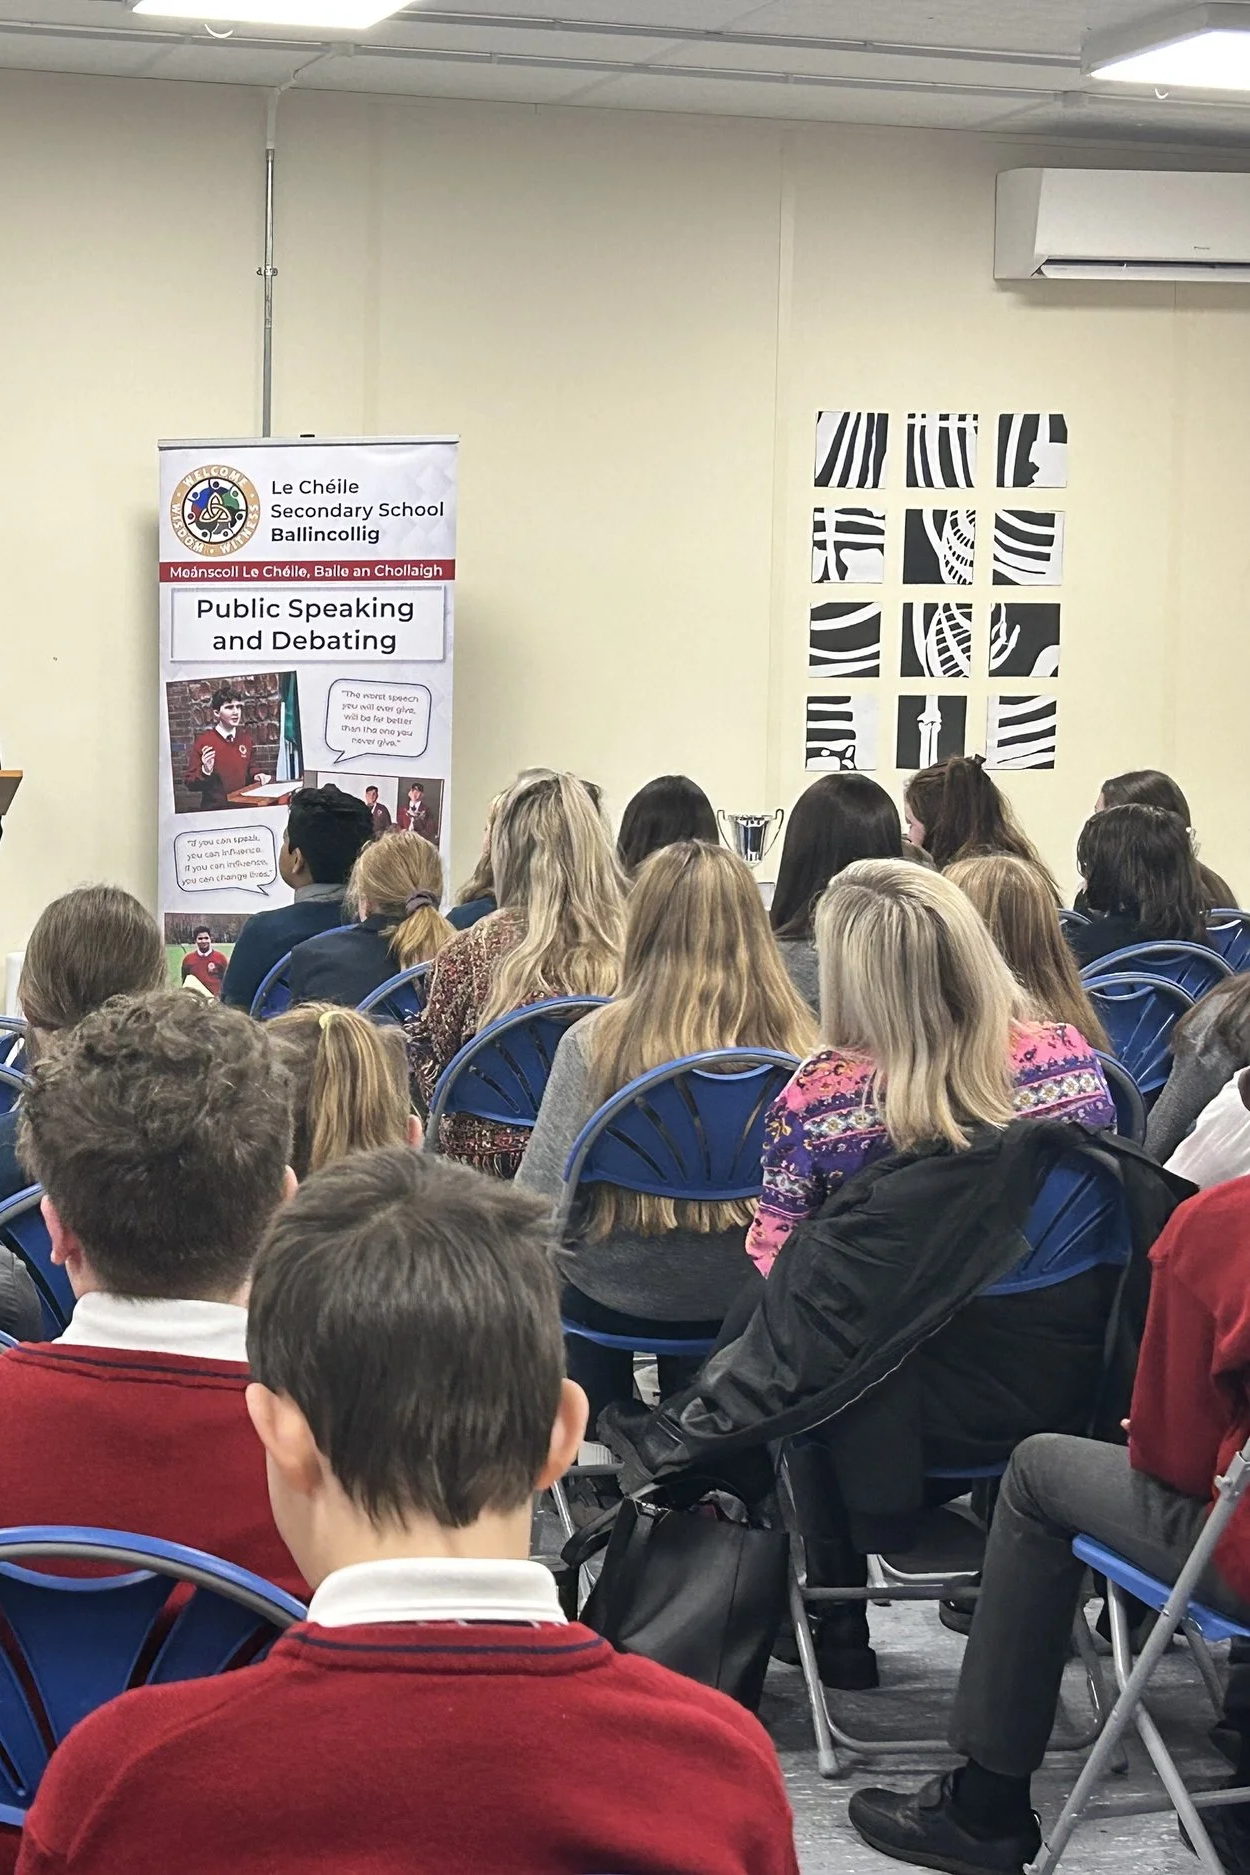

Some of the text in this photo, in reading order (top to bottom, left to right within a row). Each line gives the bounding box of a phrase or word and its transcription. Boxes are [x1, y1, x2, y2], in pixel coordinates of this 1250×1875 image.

[183, 466, 248, 487] WELCOME
[272, 479, 359, 494] Le Chéile
[271, 502, 444, 520] Secondary School
[172, 503, 205, 553] WISDOM
[220, 504, 258, 554] WITNESS
[271, 526, 379, 544] Ballincollig
[243, 566, 259, 578] Le
[353, 567, 370, 577] an
[375, 564, 442, 578] Chollaigh
[198, 597, 414, 622] Public Speaking
[213, 630, 396, 654] and Debating
